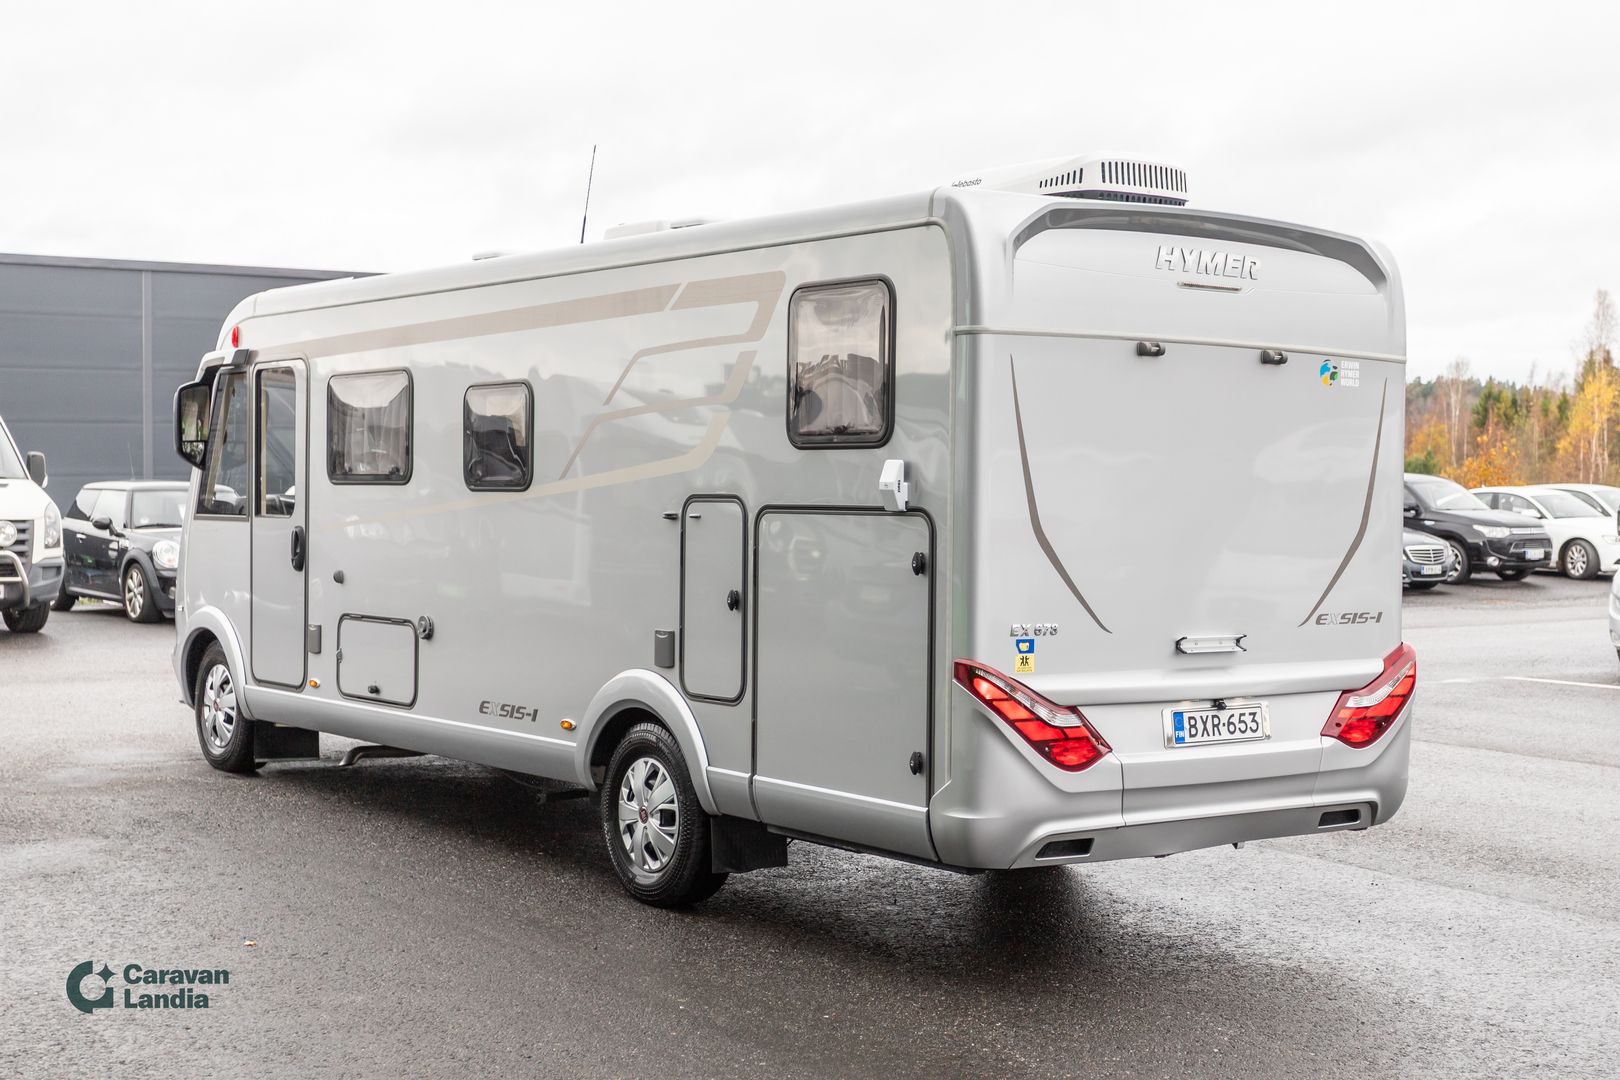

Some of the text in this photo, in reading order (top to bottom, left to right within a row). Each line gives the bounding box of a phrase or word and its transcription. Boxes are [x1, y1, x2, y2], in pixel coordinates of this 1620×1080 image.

[1155, 245, 1261, 280] HYMER
[1009, 623, 1031, 637] EX
[1187, 711, 1259, 739] BXR-653
